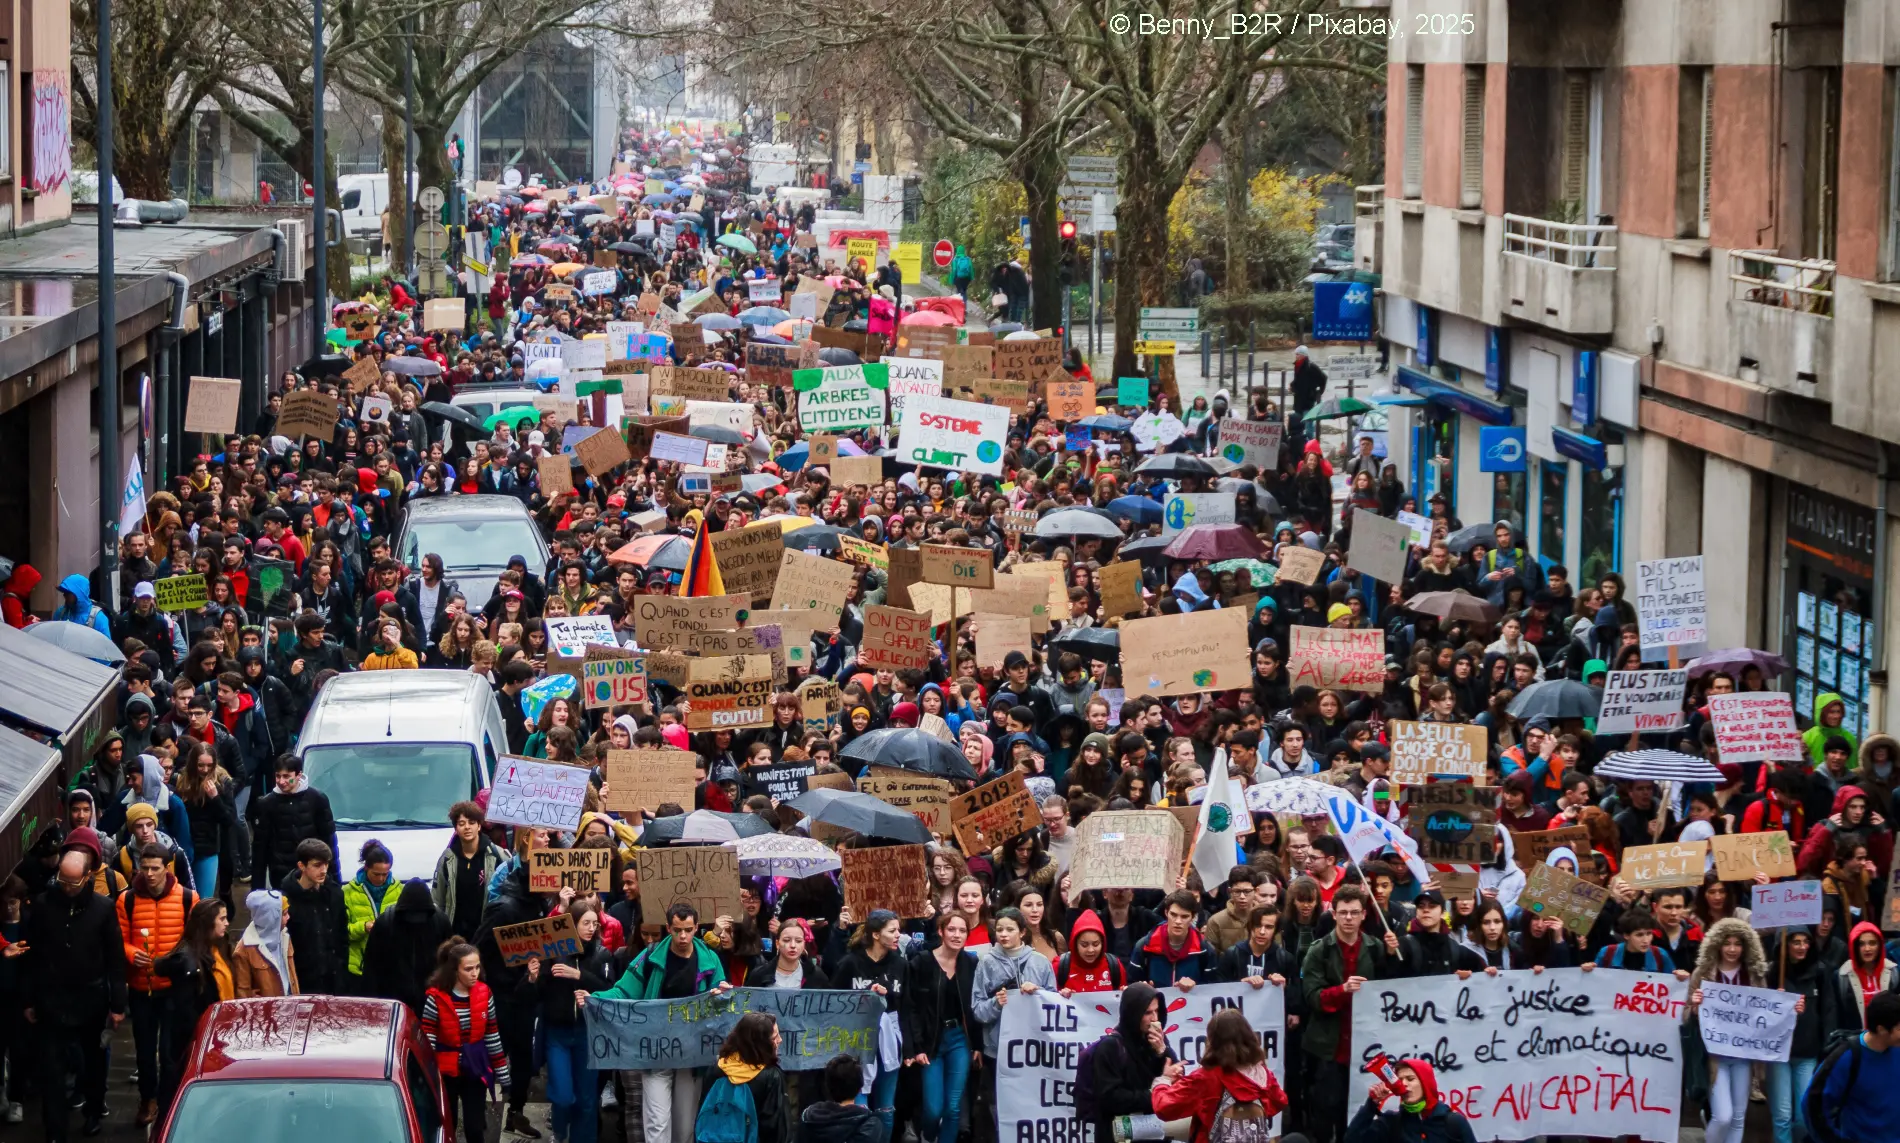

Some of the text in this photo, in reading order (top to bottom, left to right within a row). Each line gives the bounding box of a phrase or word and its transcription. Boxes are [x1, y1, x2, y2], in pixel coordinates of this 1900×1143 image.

[851, 241, 874, 249] ROUTE
[1001, 355, 1024, 368] LES
[824, 368, 861, 382] AUX
[888, 365, 934, 380] QUAND
[1005, 369, 1050, 381] PAS LA
[807, 388, 869, 405] ARBRES
[801, 406, 881, 425] CITOYENS
[919, 412, 982, 435] SYSTEME
[1222, 420, 1252, 433] CLIMATE
[1220, 432, 1241, 443] MADE
[1245, 436, 1257, 445] ME
[953, 563, 979, 577] DIE
[1668, 559, 1701, 573] MON
[158, 577, 204, 590] PAS BESOIN
[806, 573, 851, 591] VEUX PAS
[1638, 595, 1656, 608] TA
[640, 602, 731, 621] QUAND C'EST
[1655, 608, 1666, 617] LA
[551, 620, 608, 634] Ta planète
[672, 619, 708, 631] FONDU
[868, 611, 917, 632] ON EST
[1648, 616, 1704, 630] BLEUE OU
[646, 629, 680, 645] C'EST
[702, 635, 754, 650] PAS DE
[883, 631, 925, 653] CHAUD
[1295, 629, 1382, 653] LE CLIMAT
[864, 648, 904, 664] QUE LE
[584, 659, 644, 677] SAUVONS
[1295, 659, 1337, 687] AU
[692, 679, 771, 697] QUAND C'EST
[1610, 671, 1685, 690] PLUS TARD
[737, 696, 768, 708] C'EST
[1604, 689, 1682, 704] JE VOUDRAIS
[1746, 710, 1758, 720] DE
[1396, 721, 1464, 744] LA SEULE
[1716, 725, 1726, 735] LA
[1778, 720, 1788, 729] DE
[1392, 739, 1472, 761] CHOSE QUI
[1394, 755, 1431, 772] DOIT
[527, 766, 568, 782] ÇA VA
[757, 766, 815, 782] MANIFESTATION
[521, 782, 585, 804] CHAUFFER
[768, 781, 798, 792] POUR LE
[889, 796, 912, 806] TERRE
[495, 794, 582, 827] RÉAGISSEZ
[534, 851, 609, 869] TOUS DANS LA
[531, 869, 601, 892] MÊME MERDE
[1634, 865, 1652, 880] WE
[674, 878, 700, 896] ON
[500, 919, 569, 940] ARRÊTE DE
[501, 940, 540, 952] NIQUER
[543, 938, 578, 956] MER
[588, 1000, 648, 1025] VOUS
[774, 991, 872, 1020] VIEILLESSE
[1380, 979, 1595, 1028] Pour la justice
[1613, 992, 1687, 1019] PARTOUT
[1703, 988, 1783, 1015] CE QUI RISQUE
[1040, 1003, 1079, 1032] ILS
[1702, 1008, 1750, 1026] D'ARRIVER
[592, 1025, 876, 1060] ON AURA CHANCE
[1474, 1025, 1676, 1077] et climatique
[1040, 1078, 1076, 1108] LES
[1493, 1066, 1672, 1122] AU CAPITAL
